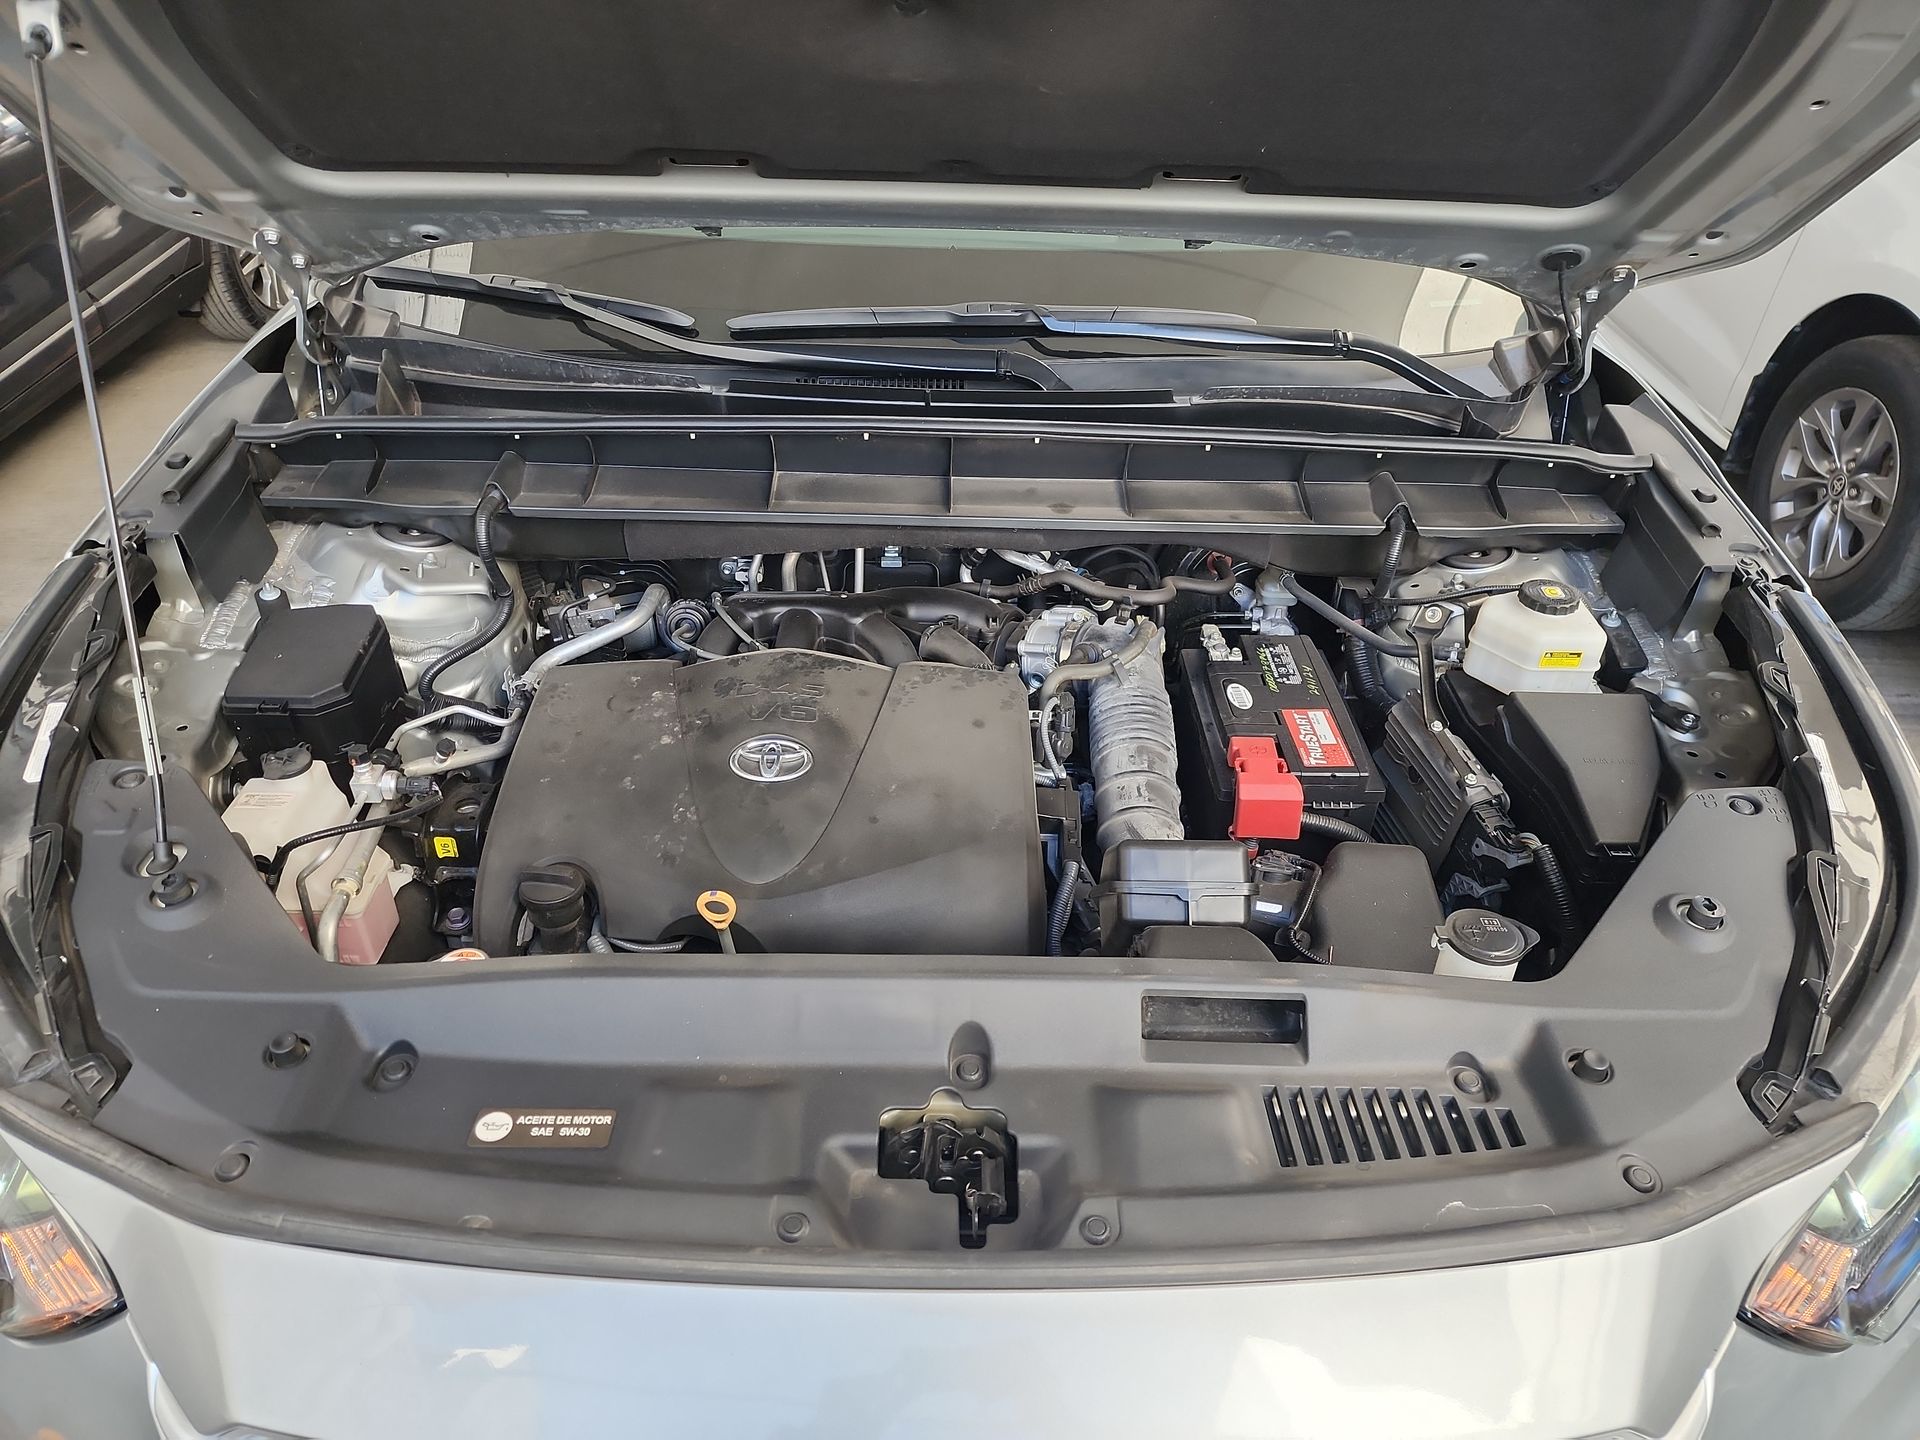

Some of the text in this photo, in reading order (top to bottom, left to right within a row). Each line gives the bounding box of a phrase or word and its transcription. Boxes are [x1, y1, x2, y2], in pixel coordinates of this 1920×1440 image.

[746, 702, 819, 722] V6
[440, 842, 451, 855] V6
[516, 1115, 612, 1125] ACEITE DE MOTOR
[530, 1127, 591, 1137] SAE 5W-30
